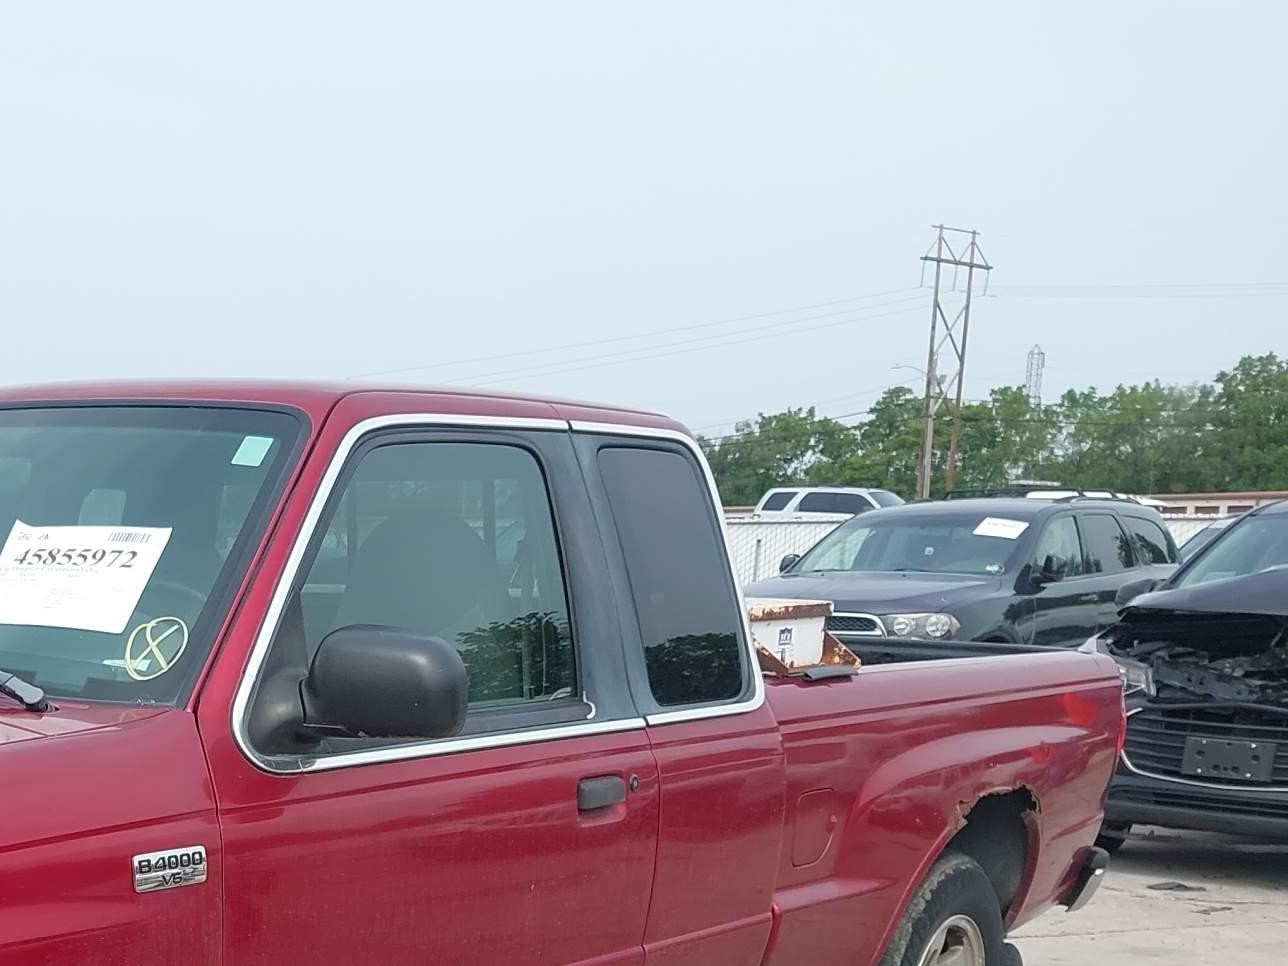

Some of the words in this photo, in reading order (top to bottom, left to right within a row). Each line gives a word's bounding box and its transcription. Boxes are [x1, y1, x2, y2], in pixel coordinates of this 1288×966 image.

[13, 547, 139, 569] 45855972
[138, 851, 203, 874] B4000
[161, 872, 183, 885] V6
